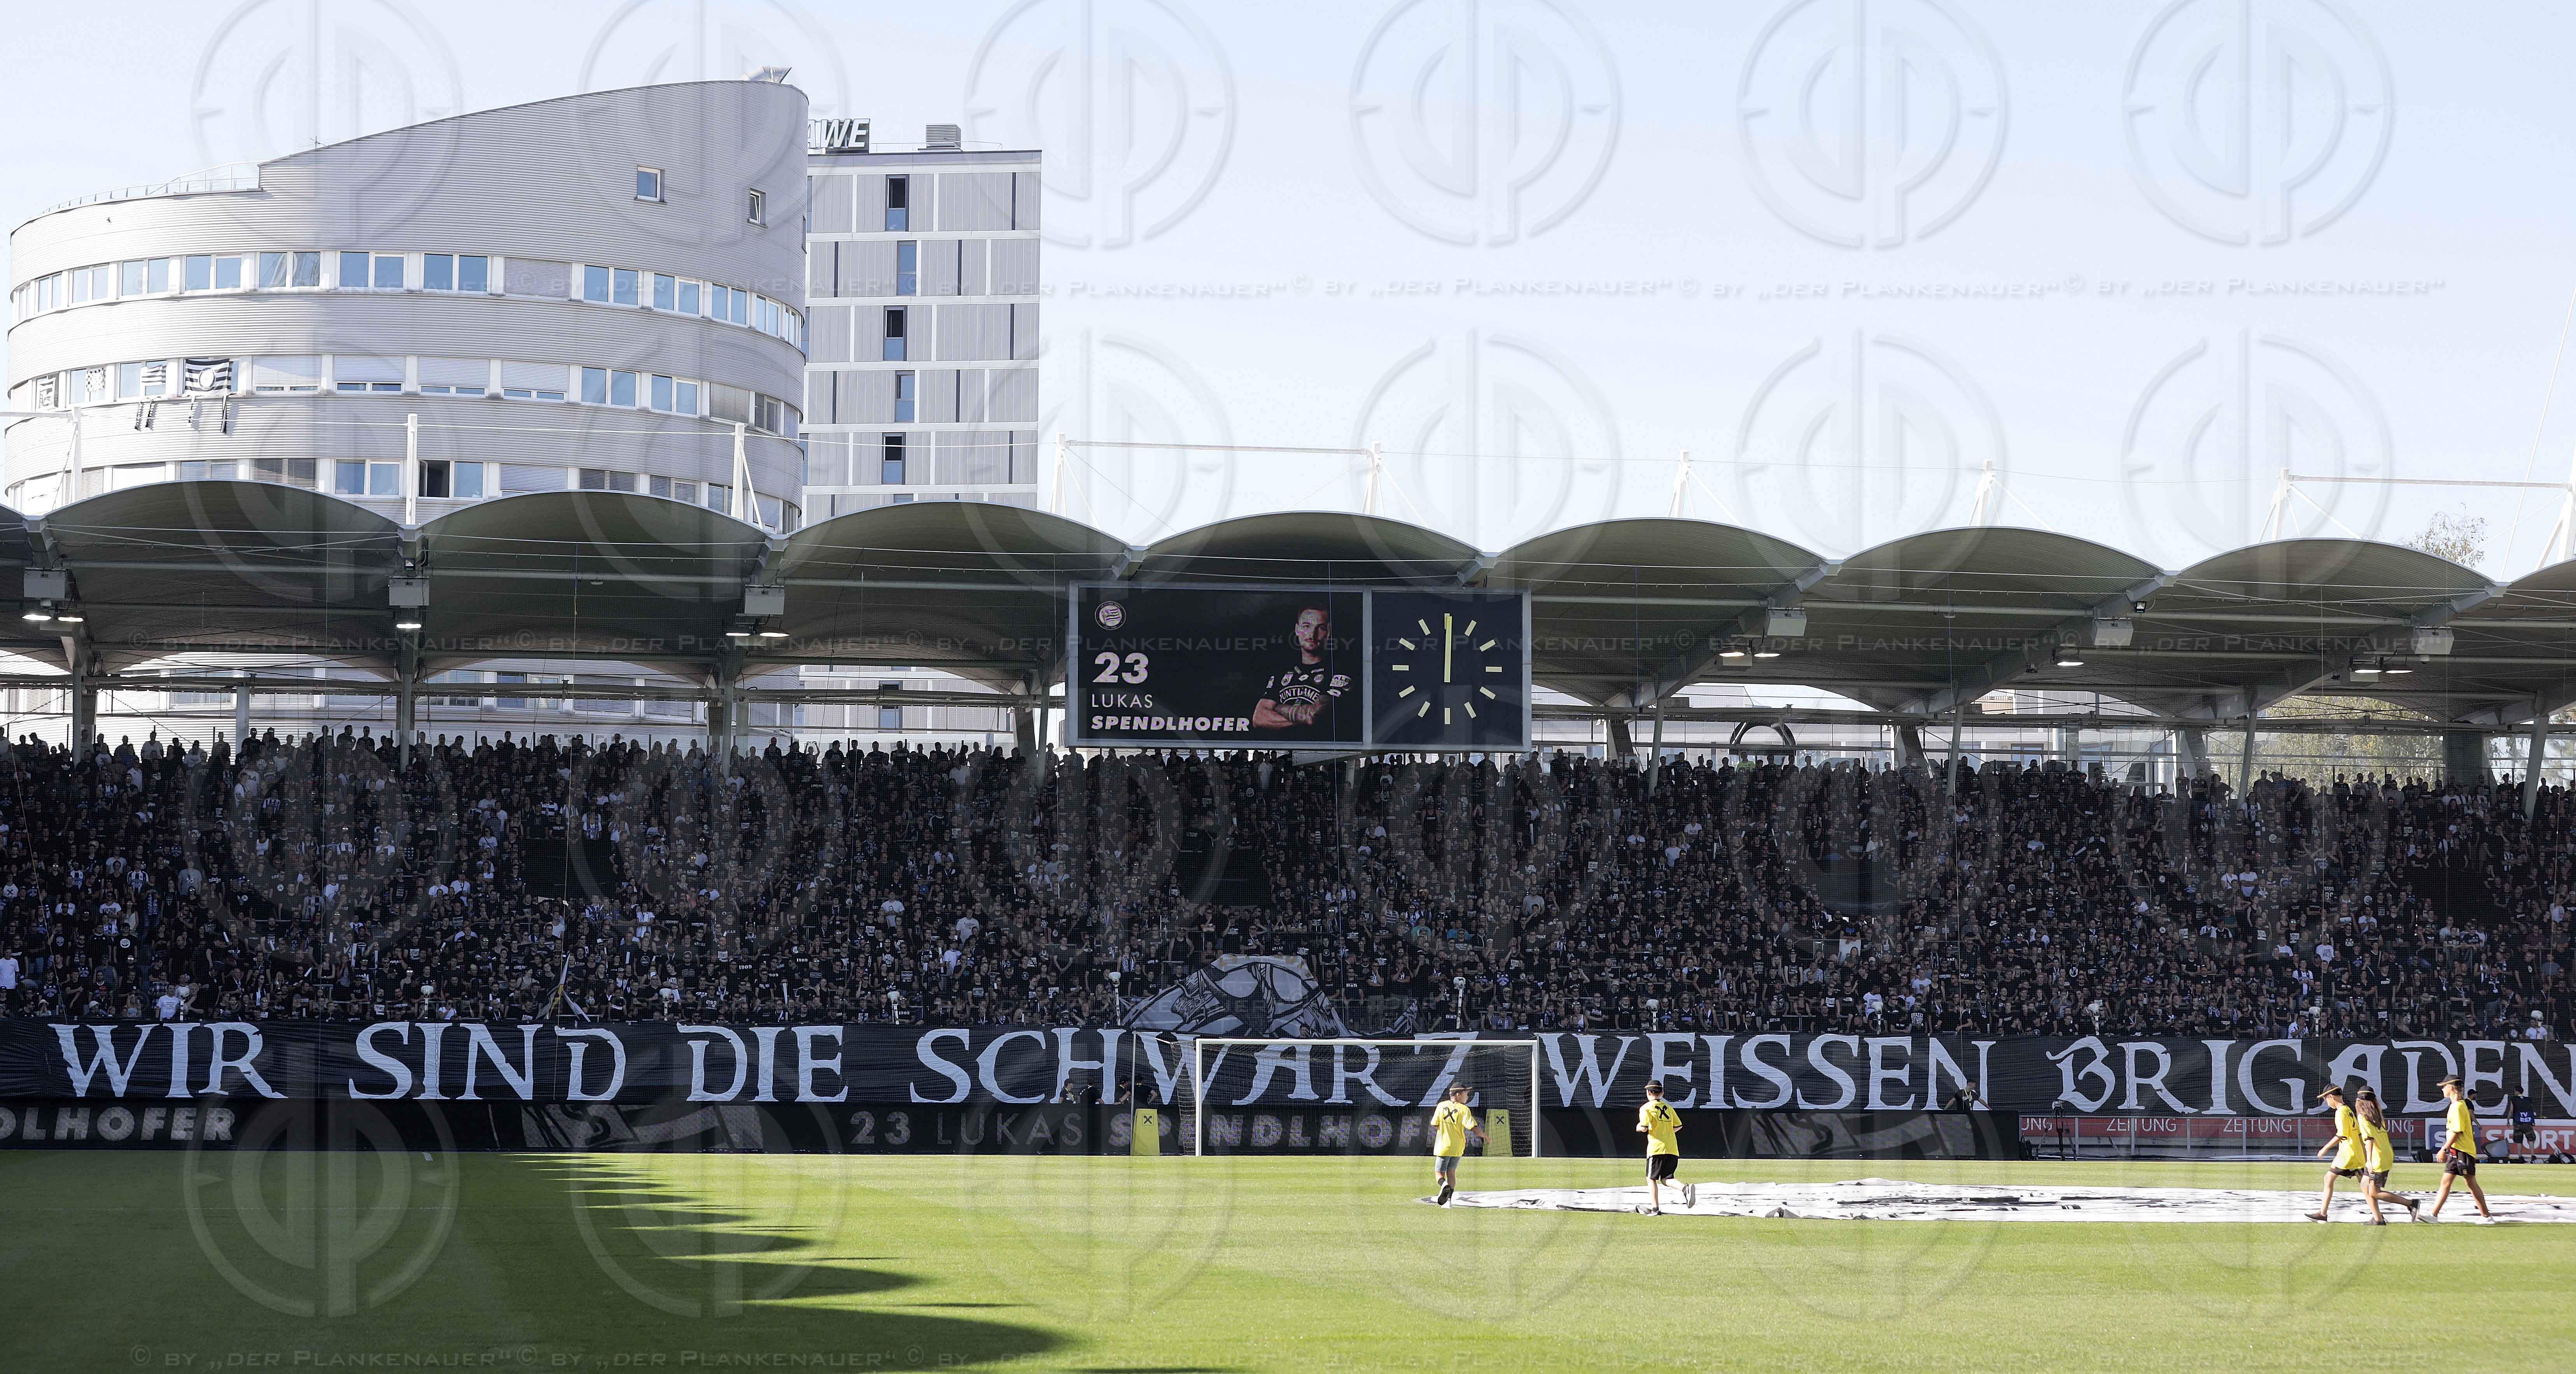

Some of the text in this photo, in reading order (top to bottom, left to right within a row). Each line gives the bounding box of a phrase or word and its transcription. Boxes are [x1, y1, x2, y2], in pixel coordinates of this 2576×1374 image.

[1092, 652, 1149, 684] 23
[1092, 694, 1153, 708] LUKAS
[1091, 716, 1250, 731] SPENDLHOFER
[47, 1022, 2576, 1119] WIR SIND DIE SCHWARZ WEISSEN BRIGADEN
[850, 1111, 910, 1145] 23
[937, 1112, 1083, 1146] LUKAS
[2223, 1118, 2292, 1133] ZEITUNG
